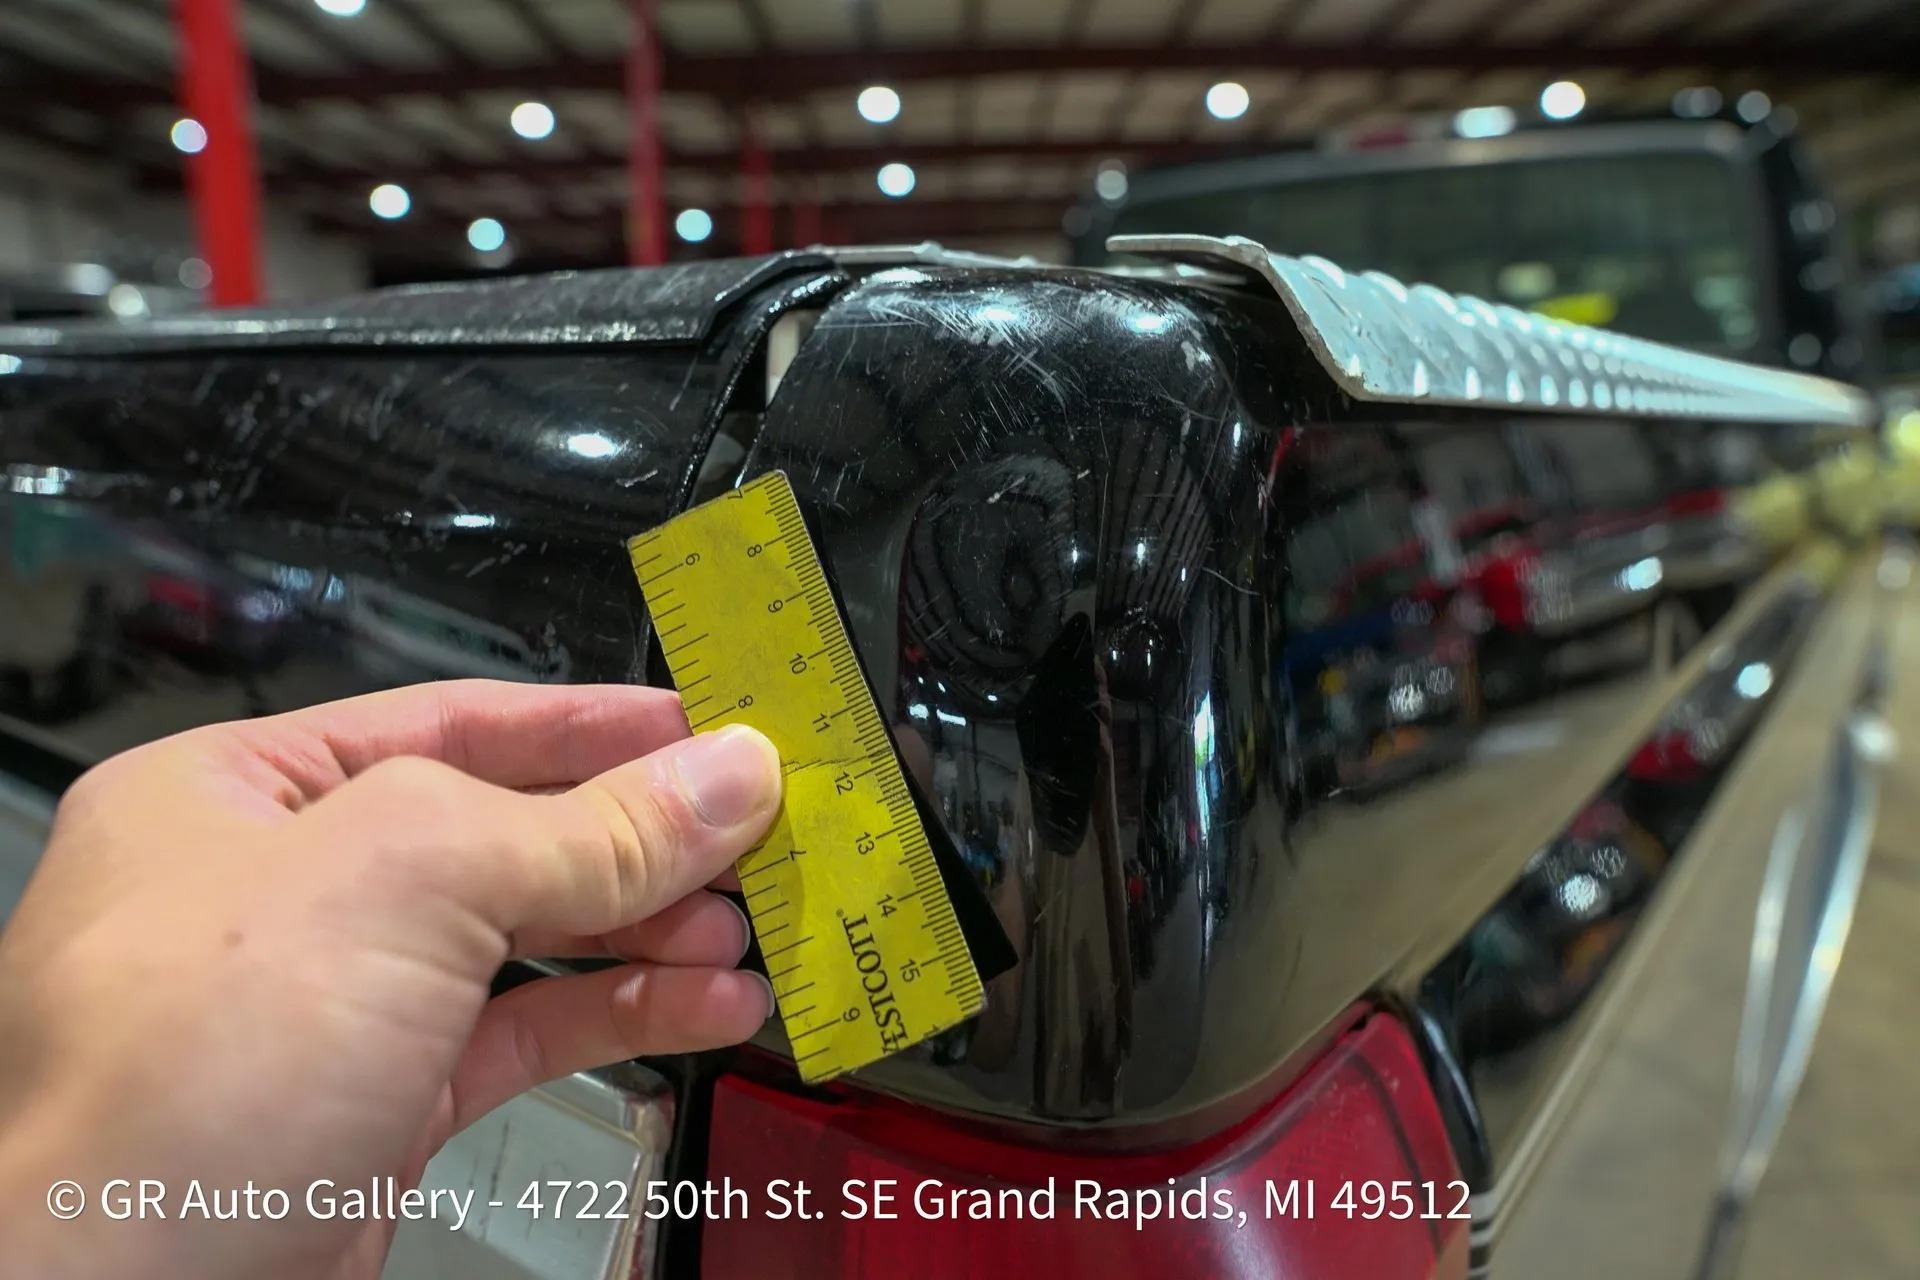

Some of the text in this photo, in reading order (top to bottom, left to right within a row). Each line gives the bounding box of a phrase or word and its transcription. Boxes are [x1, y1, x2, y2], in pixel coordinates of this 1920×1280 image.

[727, 489, 744, 501] 7
[746, 544, 763, 558] 8
[767, 599, 784, 614] 9
[789, 652, 808, 675] 10
[812, 712, 831, 734] 11
[834, 771, 854, 796] 12
[855, 831, 875, 856] 13
[876, 893, 897, 919] 14
[899, 958, 921, 983] 15
[738, 695, 754, 709] 8
[789, 849, 807, 862] 7
